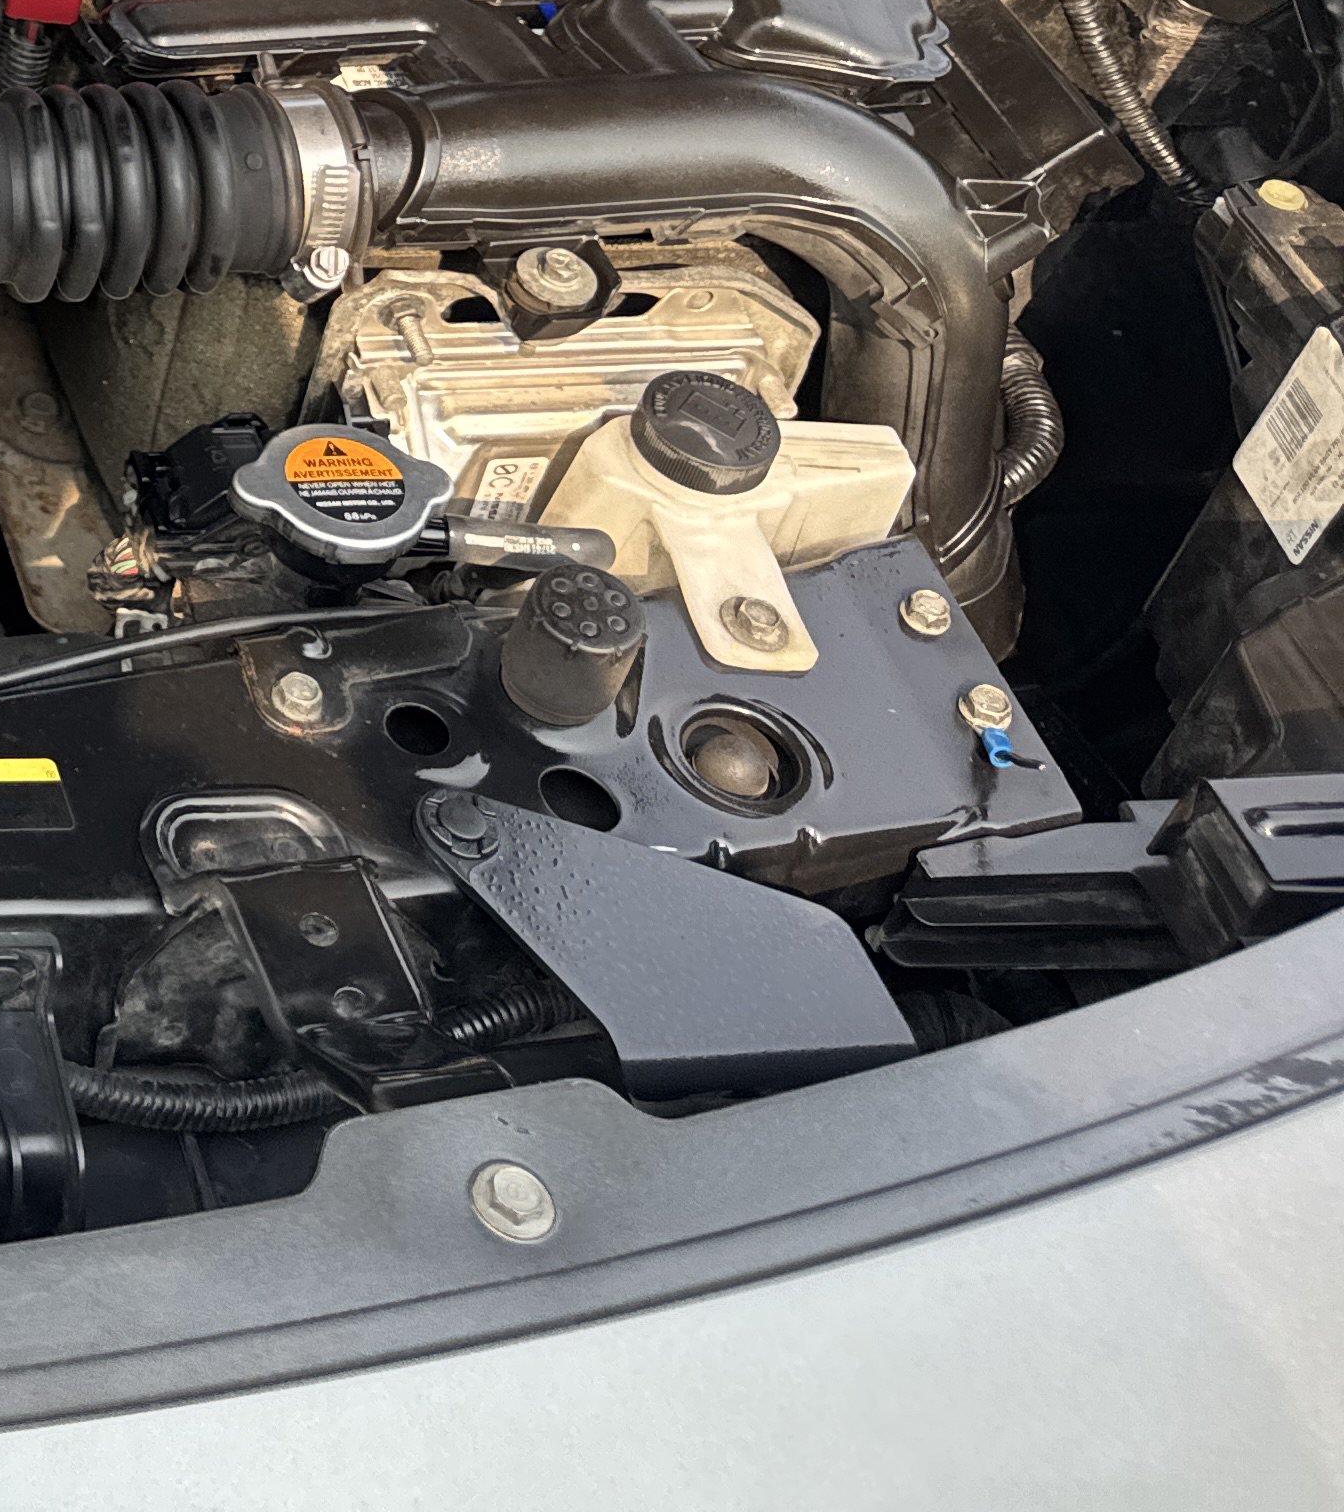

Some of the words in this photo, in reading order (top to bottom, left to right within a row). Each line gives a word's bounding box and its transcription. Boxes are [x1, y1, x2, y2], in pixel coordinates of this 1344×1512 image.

[303, 457, 373, 468] WARNING
[293, 468, 393, 479] AVERTISSEMENT
[298, 481, 326, 489] NEVER
[1293, 518, 1320, 557] NISSAN
